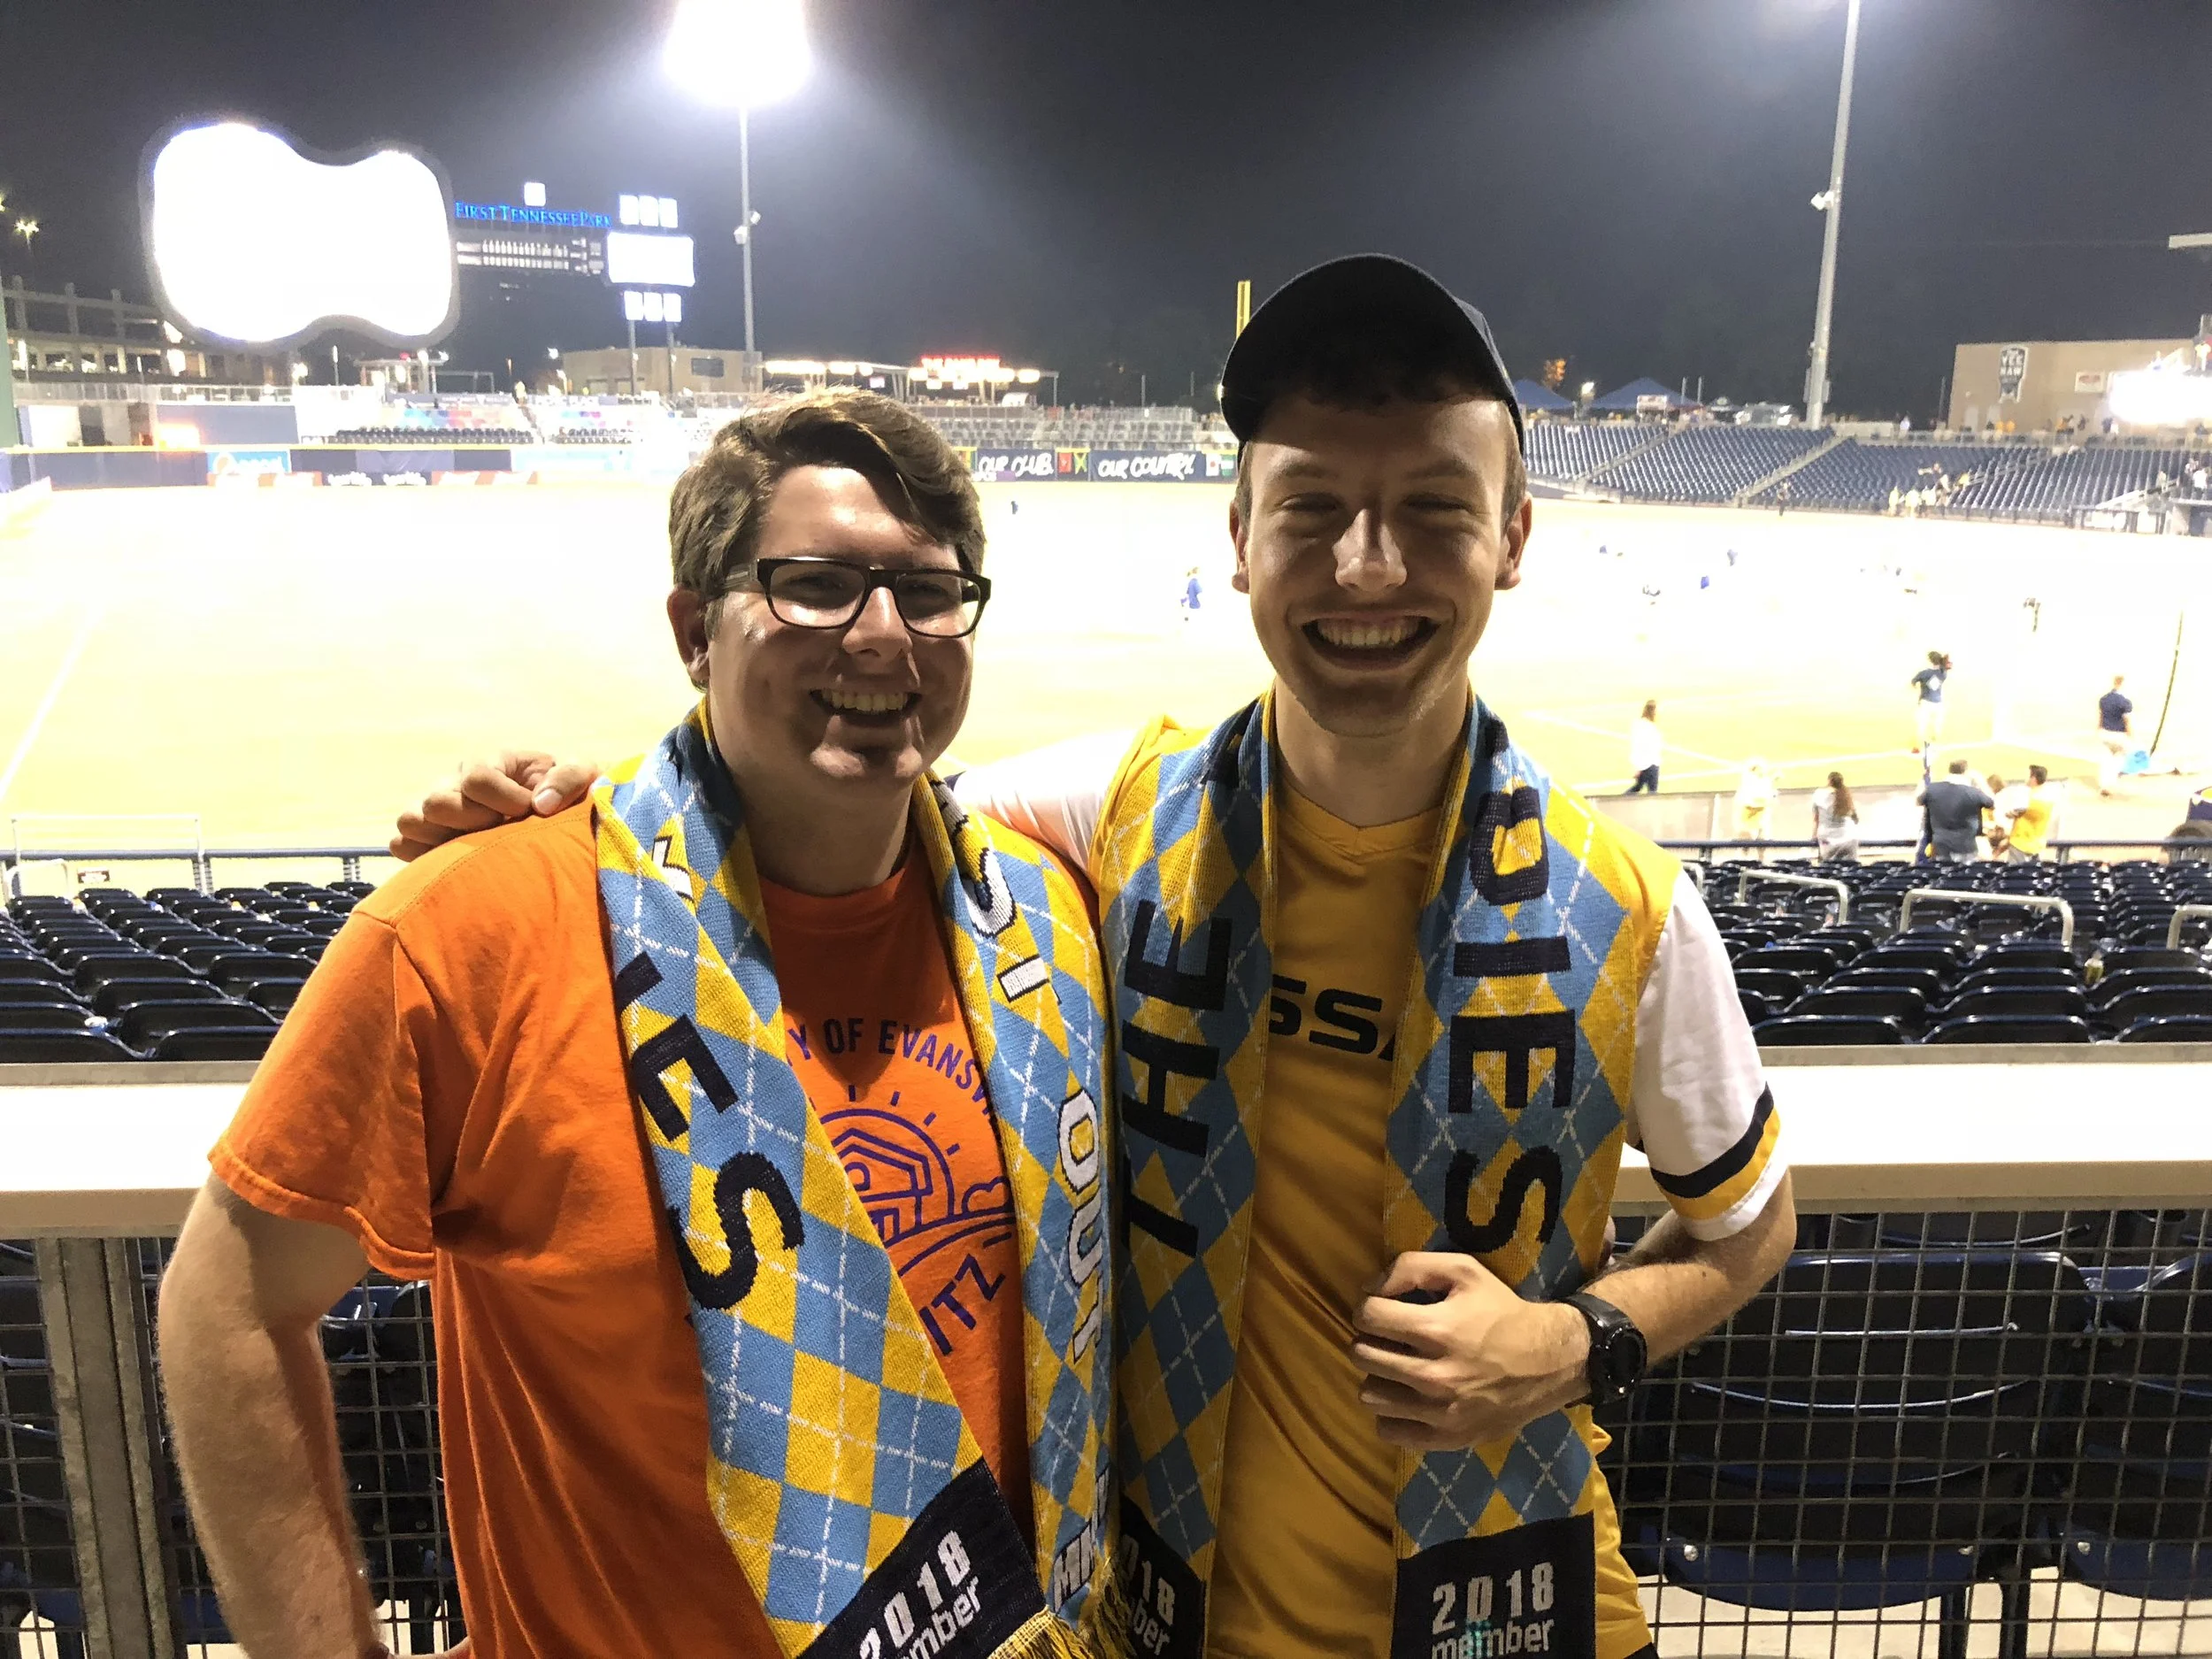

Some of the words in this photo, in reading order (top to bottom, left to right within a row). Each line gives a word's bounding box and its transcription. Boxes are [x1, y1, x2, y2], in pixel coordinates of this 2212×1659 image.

[455, 202, 497, 220] FIRST
[1098, 458, 1129, 478] OUR
[823, 1017, 864, 1055] OF
[1269, 973, 1395, 1063] SS
[1121, 898, 1233, 1258] THE
[918, 1253, 1006, 1356] ITZ
[1118, 1533, 1176, 1628] 018
[1431, 1561, 1555, 1635] 2018
[1431, 1617, 1555, 1659] member
